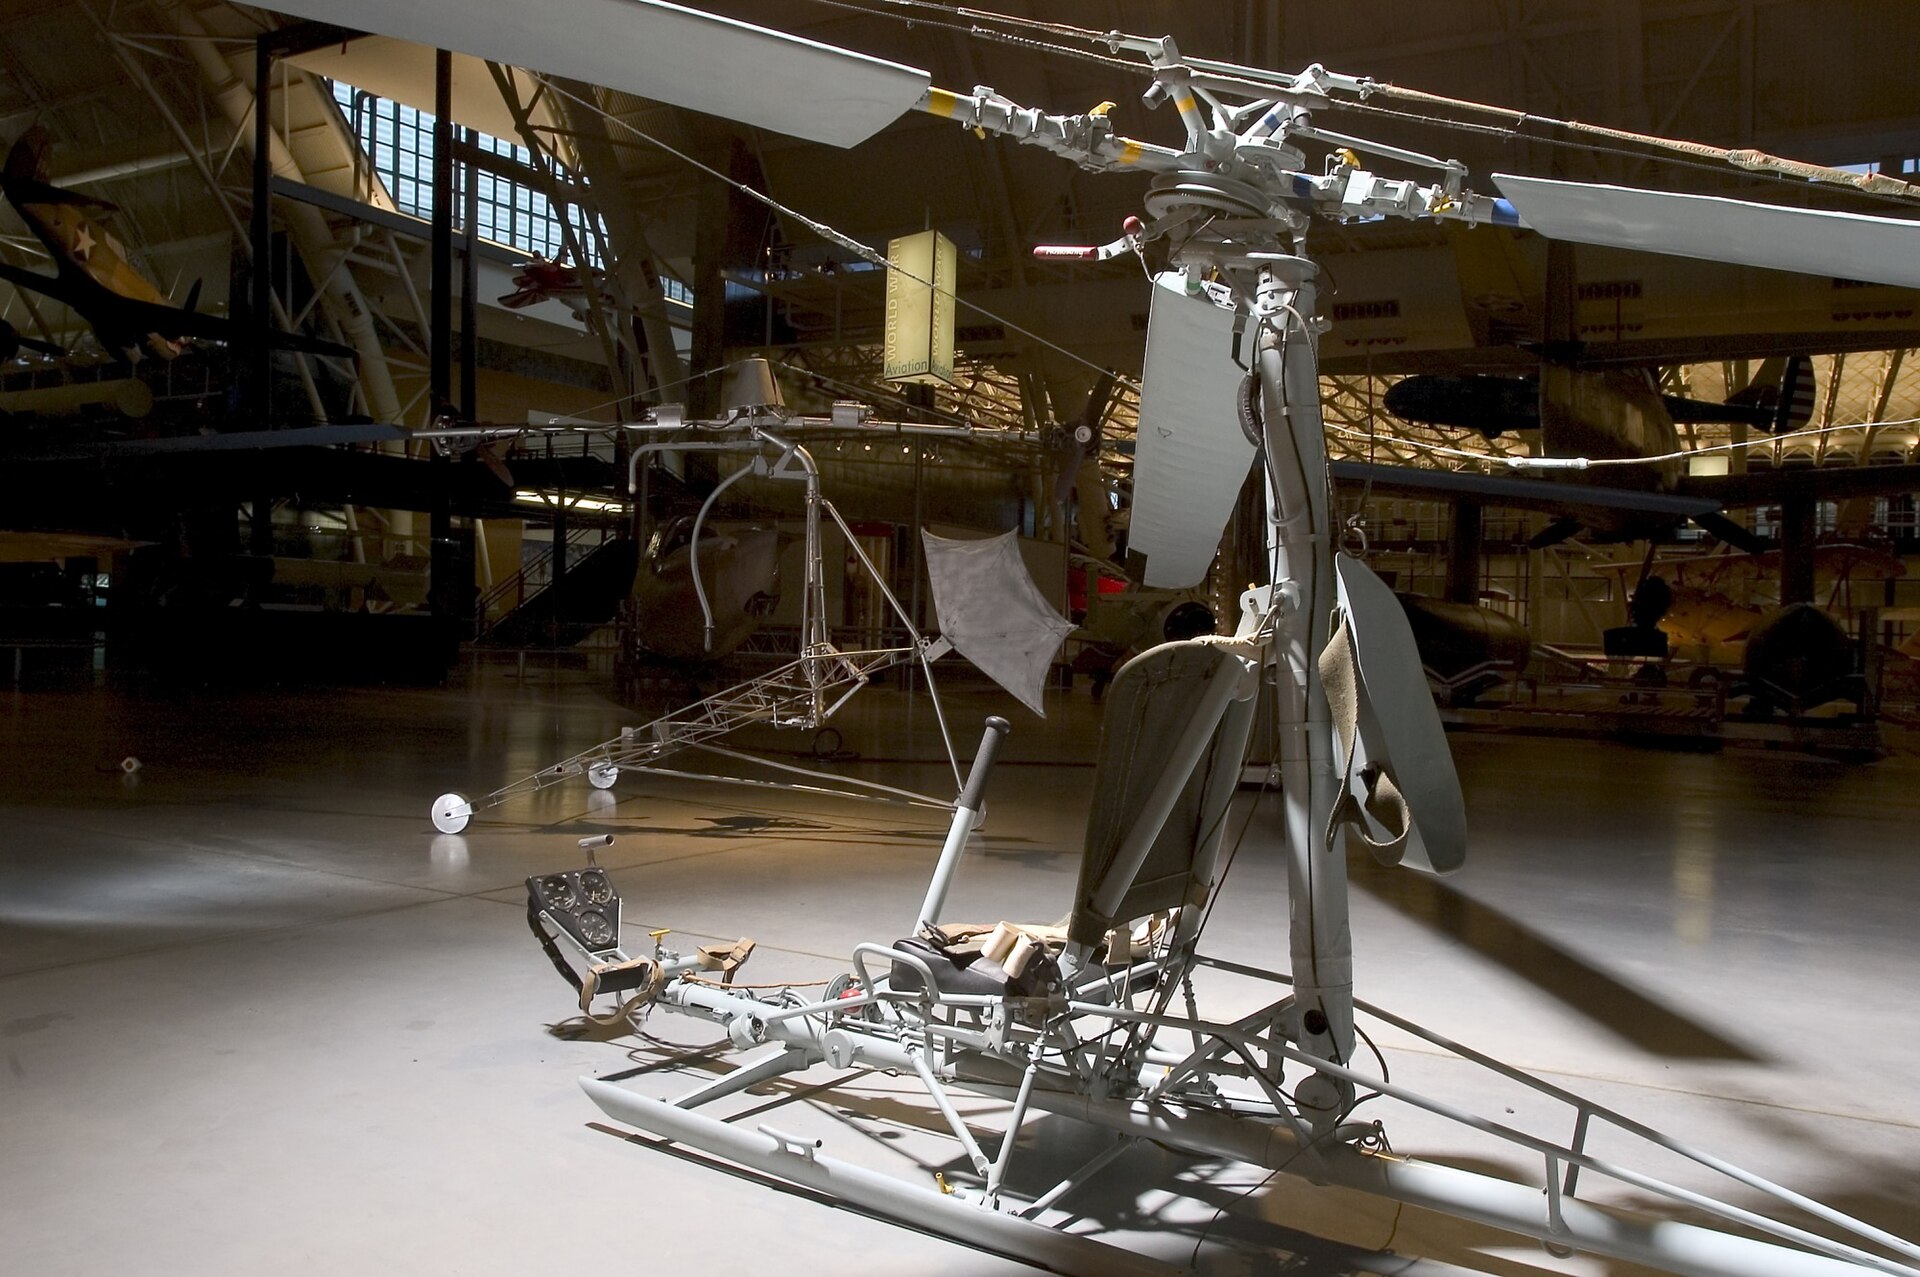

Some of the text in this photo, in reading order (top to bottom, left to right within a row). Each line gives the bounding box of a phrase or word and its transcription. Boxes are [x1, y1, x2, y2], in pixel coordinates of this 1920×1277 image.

[889, 254, 899, 293] WAR
[935, 249, 943, 287] WAR
[887, 299, 897, 361] WORLD
[933, 294, 941, 356] WORLD
[885, 359, 927, 376] Aviation
[931, 359, 952, 379] Aviation
